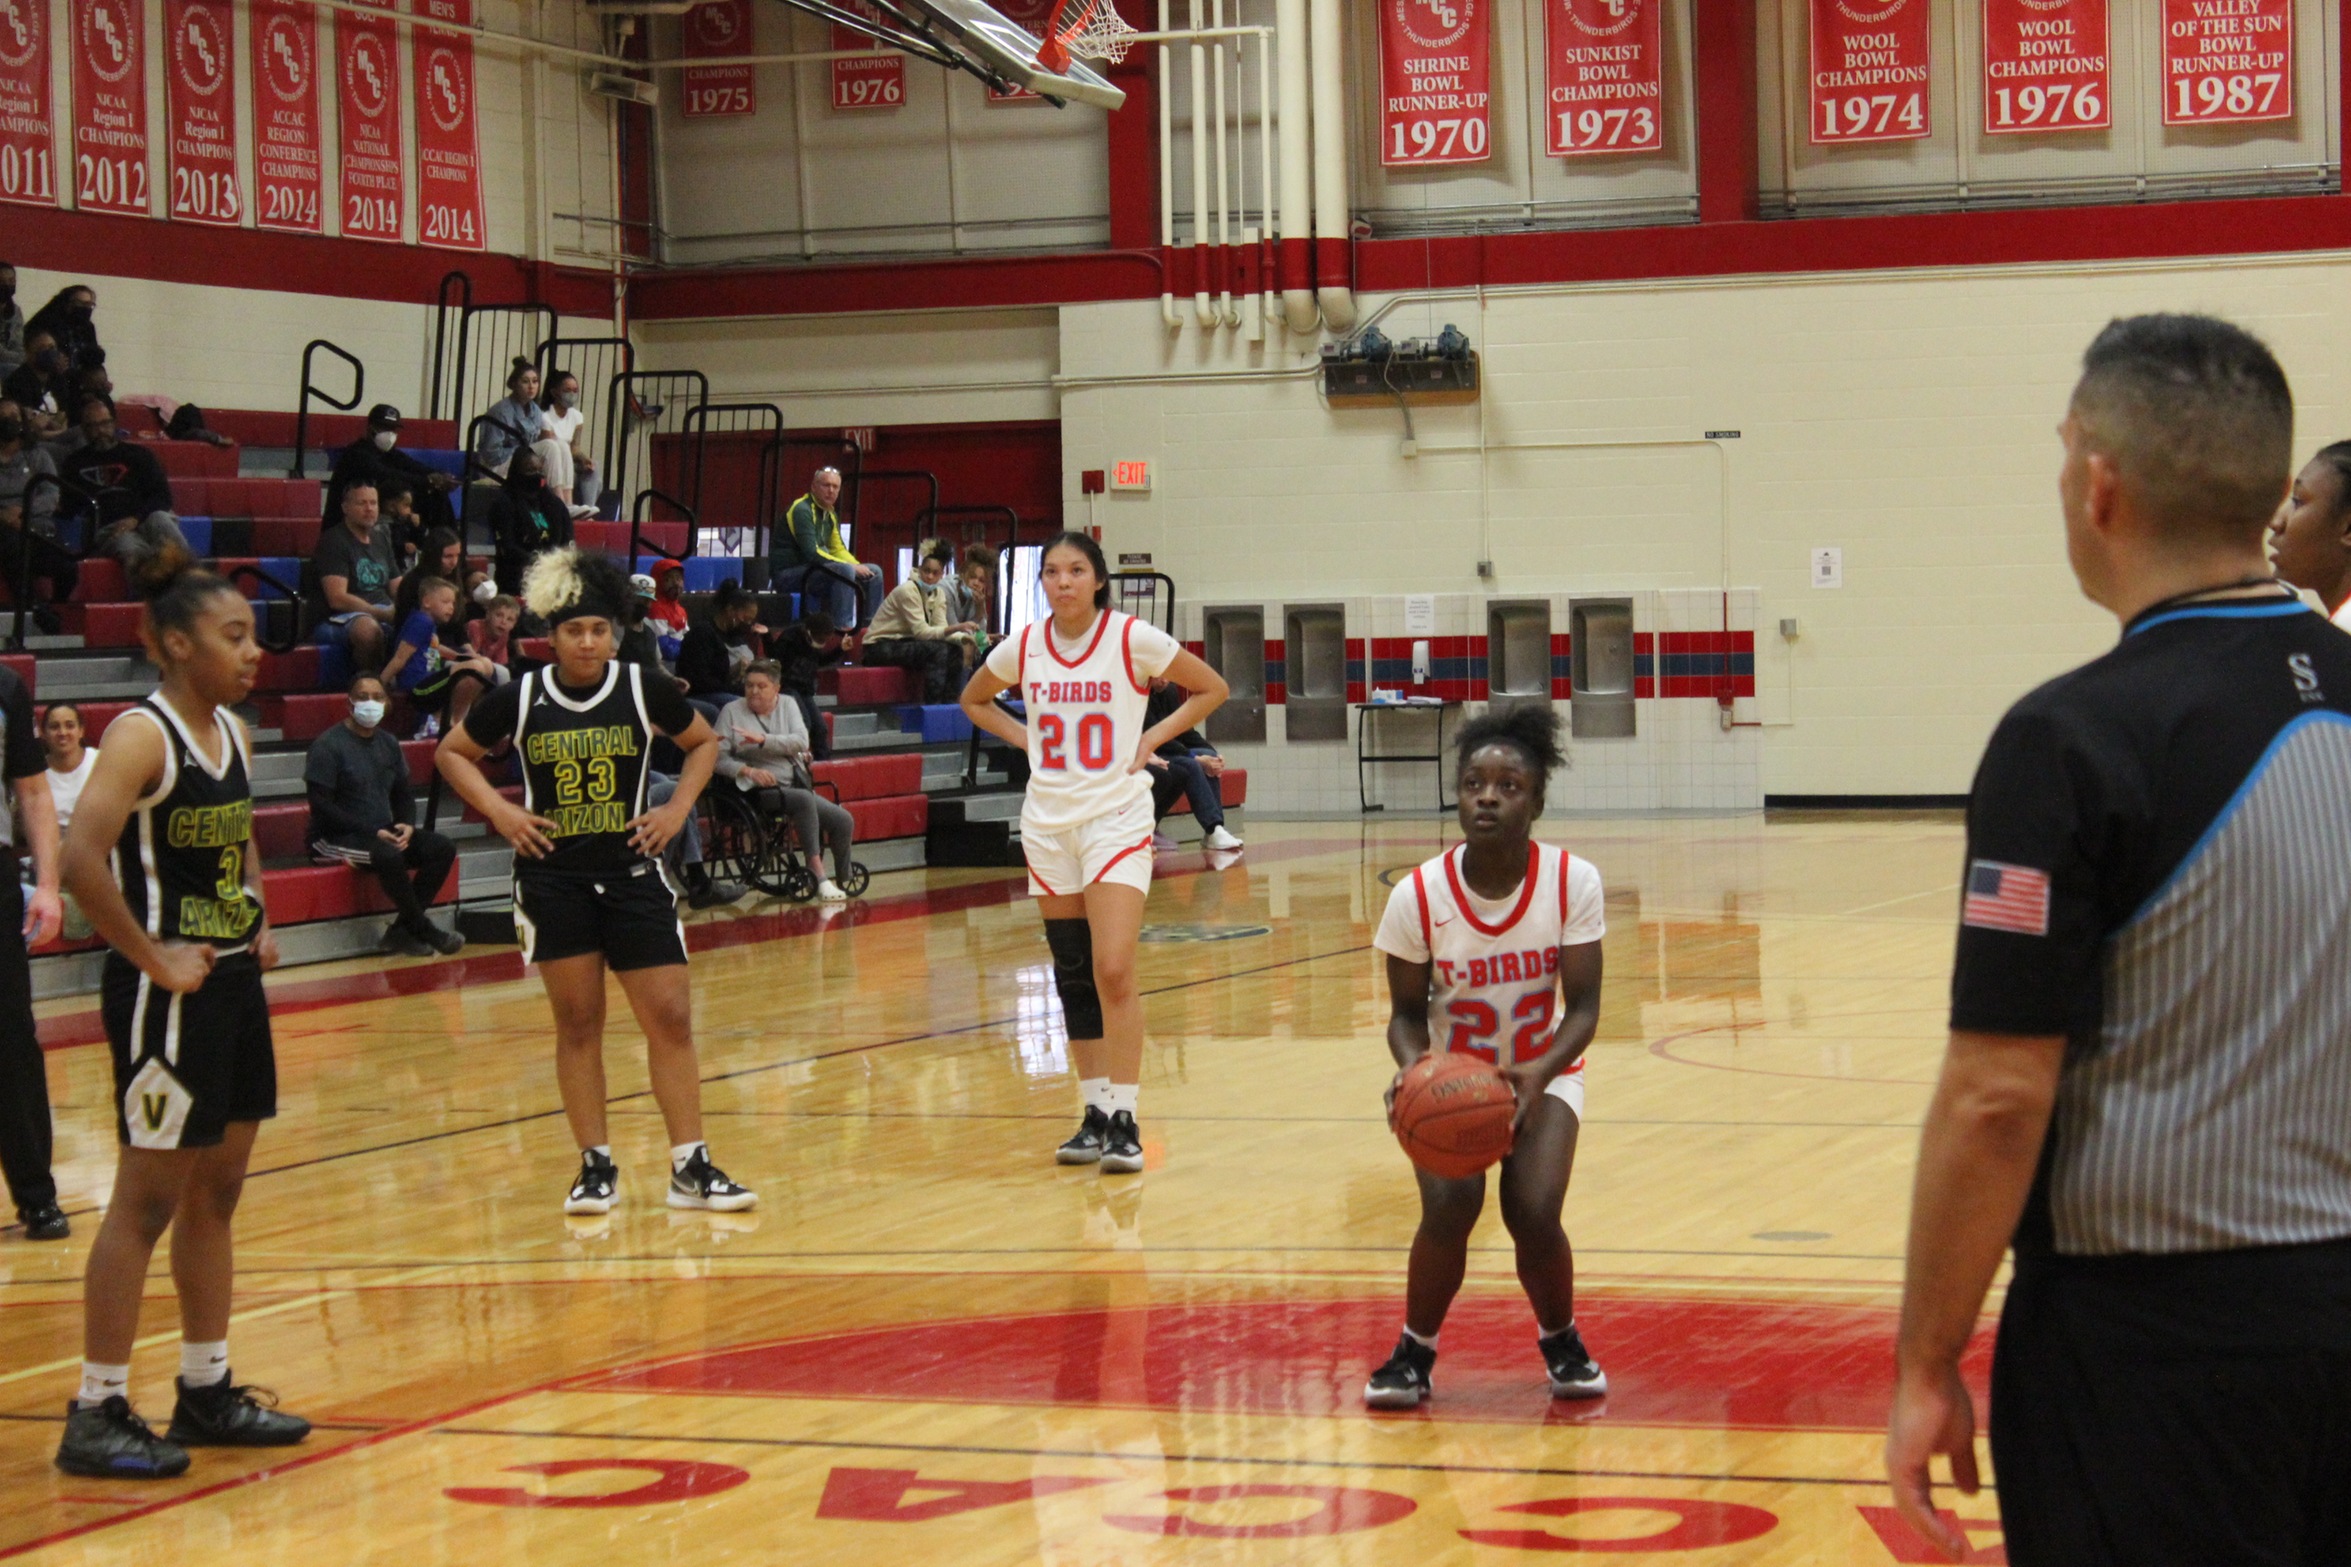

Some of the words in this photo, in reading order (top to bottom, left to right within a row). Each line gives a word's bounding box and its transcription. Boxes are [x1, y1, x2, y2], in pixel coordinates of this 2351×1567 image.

[2192, 0, 2261, 18] VALLEY
[1570, 10, 1638, 36] THUNDERBIRDS
[2018, 19, 2075, 37] WOOL
[2171, 21, 2197, 38] OF
[2201, 18, 2240, 36] THE
[2243, 16, 2282, 33] SUN
[94, 7, 123, 62] MCC
[1402, 22, 1470, 48] THUNDERBIRDS
[1843, 33, 1900, 51] WOOL
[2199, 36, 2257, 54] BOWL
[188, 23, 215, 76] MCC
[274, 32, 299, 83] MCC
[1566, 44, 1642, 64] SUNKIST
[2019, 39, 2075, 57] BOWL
[838, 57, 899, 72] CHAMPIONS
[1403, 56, 1470, 75] SHRINE
[1844, 51, 1900, 69] BOWL
[1989, 56, 2105, 78] CHAMPIONS
[2172, 52, 2285, 74] RUNNER-UP
[357, 49, 381, 98] MCC
[688, 67, 749, 81] CHAMPIONS
[1411, 75, 1464, 93] BOWL
[1578, 64, 1631, 82] BOWL
[1816, 65, 1927, 88] CHAMPIONS
[434, 65, 457, 113] MCC
[839, 78, 900, 105] 1976
[1551, 81, 1658, 103] CHAMPIONS
[2174, 73, 2282, 117] 1987
[96, 93, 127, 109] NJCAA
[690, 88, 749, 113] 1975
[1388, 92, 1488, 113] RUNNER-UP
[1995, 82, 2101, 126] 1976
[93, 108, 126, 129] Region
[189, 106, 219, 122] NJCAA
[272, 110, 306, 127] ACCAC
[1821, 93, 1924, 136] 1974
[0, 116, 49, 137] AMPIONS
[185, 121, 218, 141] Region
[267, 126, 305, 144] REGION
[1557, 107, 1655, 148] 1973
[79, 127, 145, 149] CHAMPIONS
[353, 140, 390, 156] NATIONAL
[1390, 117, 1486, 159] 1970
[176, 139, 233, 161] CHAMPIONS
[260, 143, 318, 164] CONFERENCE
[1, 143, 53, 198] 011
[262, 161, 317, 182] CHAMPIONS
[345, 154, 399, 175] CHAMPIONSHIPS
[427, 165, 467, 182] CHAMPIONS
[80, 154, 147, 208] 2012
[175, 166, 238, 219] 2013
[265, 184, 317, 223] 2014
[347, 195, 398, 233] 2014
[425, 204, 475, 241] 2014
[845, 428, 874, 451] EXIT
[1117, 461, 1147, 485] EXIT
[1029, 681, 1112, 704] T-BIRDS
[527, 725, 638, 765] CENTRAL
[1038, 712, 1115, 772] 20
[554, 756, 616, 805] 23
[215, 844, 243, 901] 3
[1437, 946, 1559, 988] T-BIRDS
[1446, 986, 1556, 1065] 22
[142, 1092, 168, 1131] V
